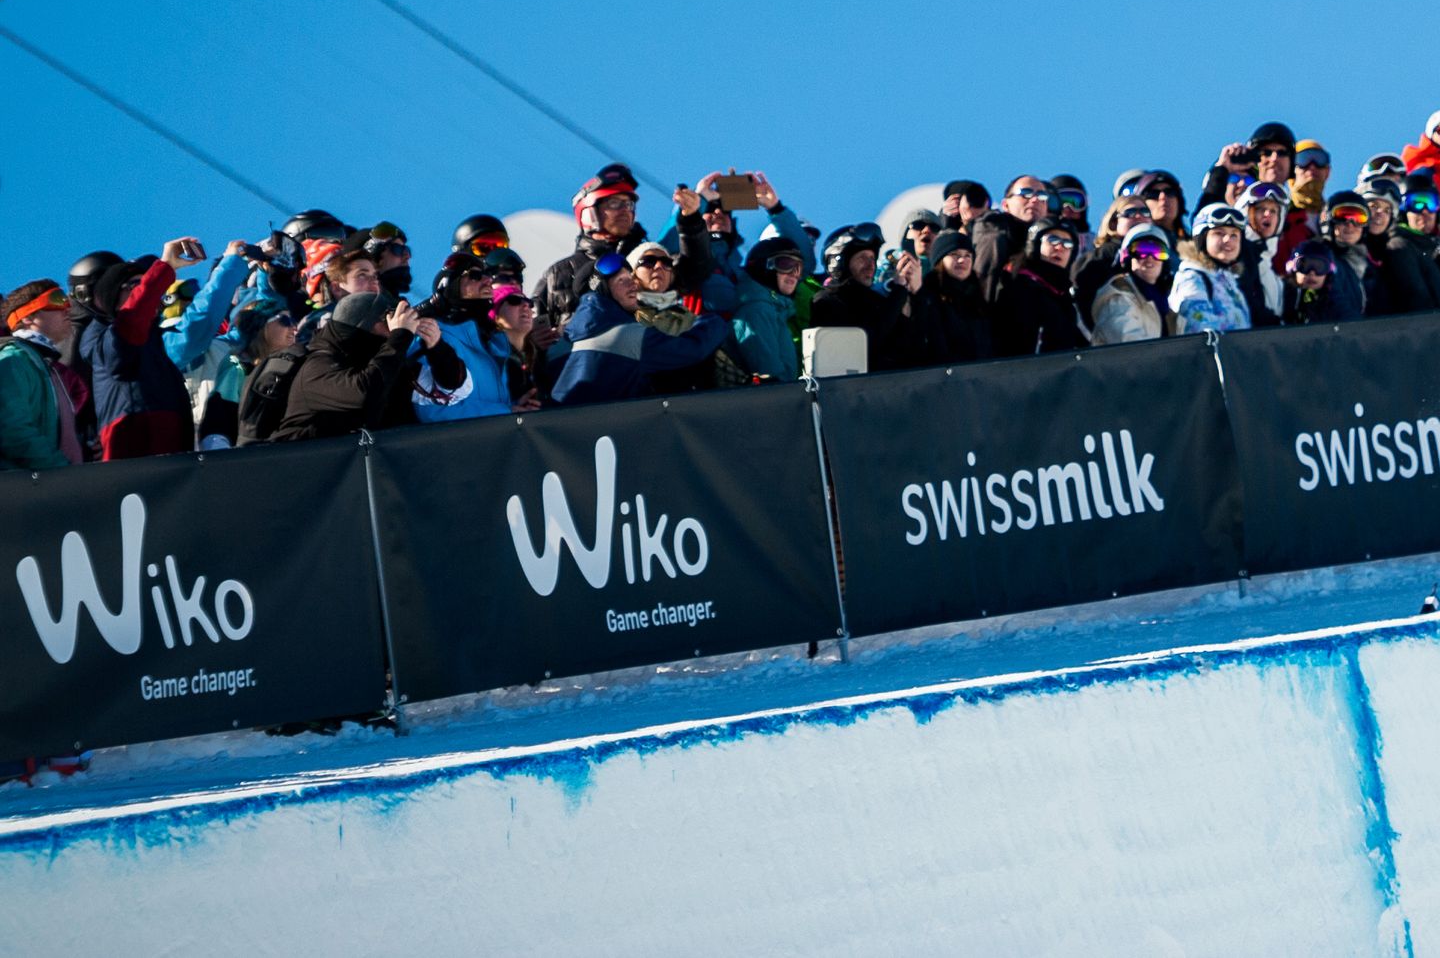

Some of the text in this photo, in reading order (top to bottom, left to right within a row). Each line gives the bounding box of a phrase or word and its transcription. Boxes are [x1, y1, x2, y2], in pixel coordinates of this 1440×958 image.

[506, 435, 710, 597] Wiko
[902, 429, 1165, 545] swissmilk
[16, 493, 255, 664] Wiko
[606, 600, 715, 633] Game changer.
[140, 668, 257, 700] Game changer.
